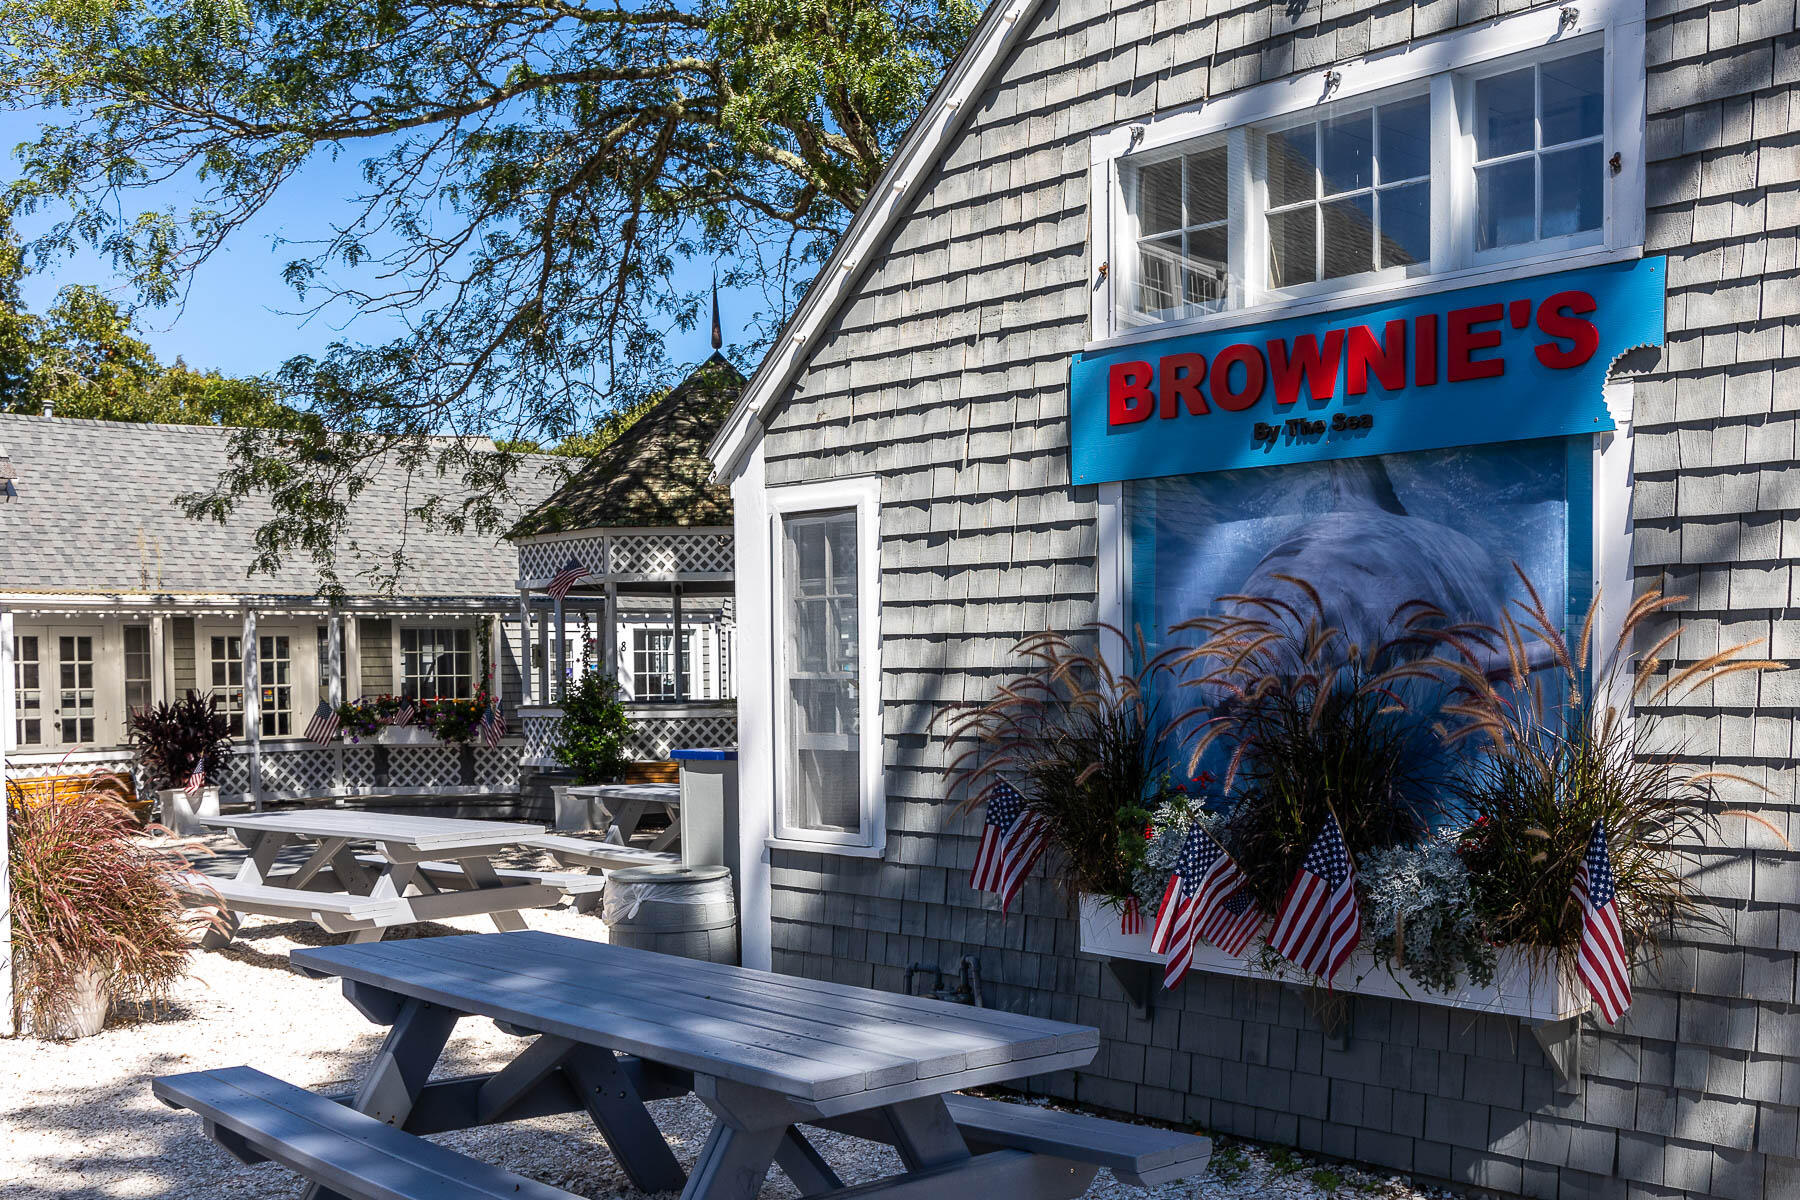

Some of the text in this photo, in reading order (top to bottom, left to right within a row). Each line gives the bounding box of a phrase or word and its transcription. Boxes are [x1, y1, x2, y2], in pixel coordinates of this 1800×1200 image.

[1109, 291, 1600, 426] BROWNIE'S
[1253, 412, 1374, 443] By The Sea
[621, 641, 626, 651] 8
